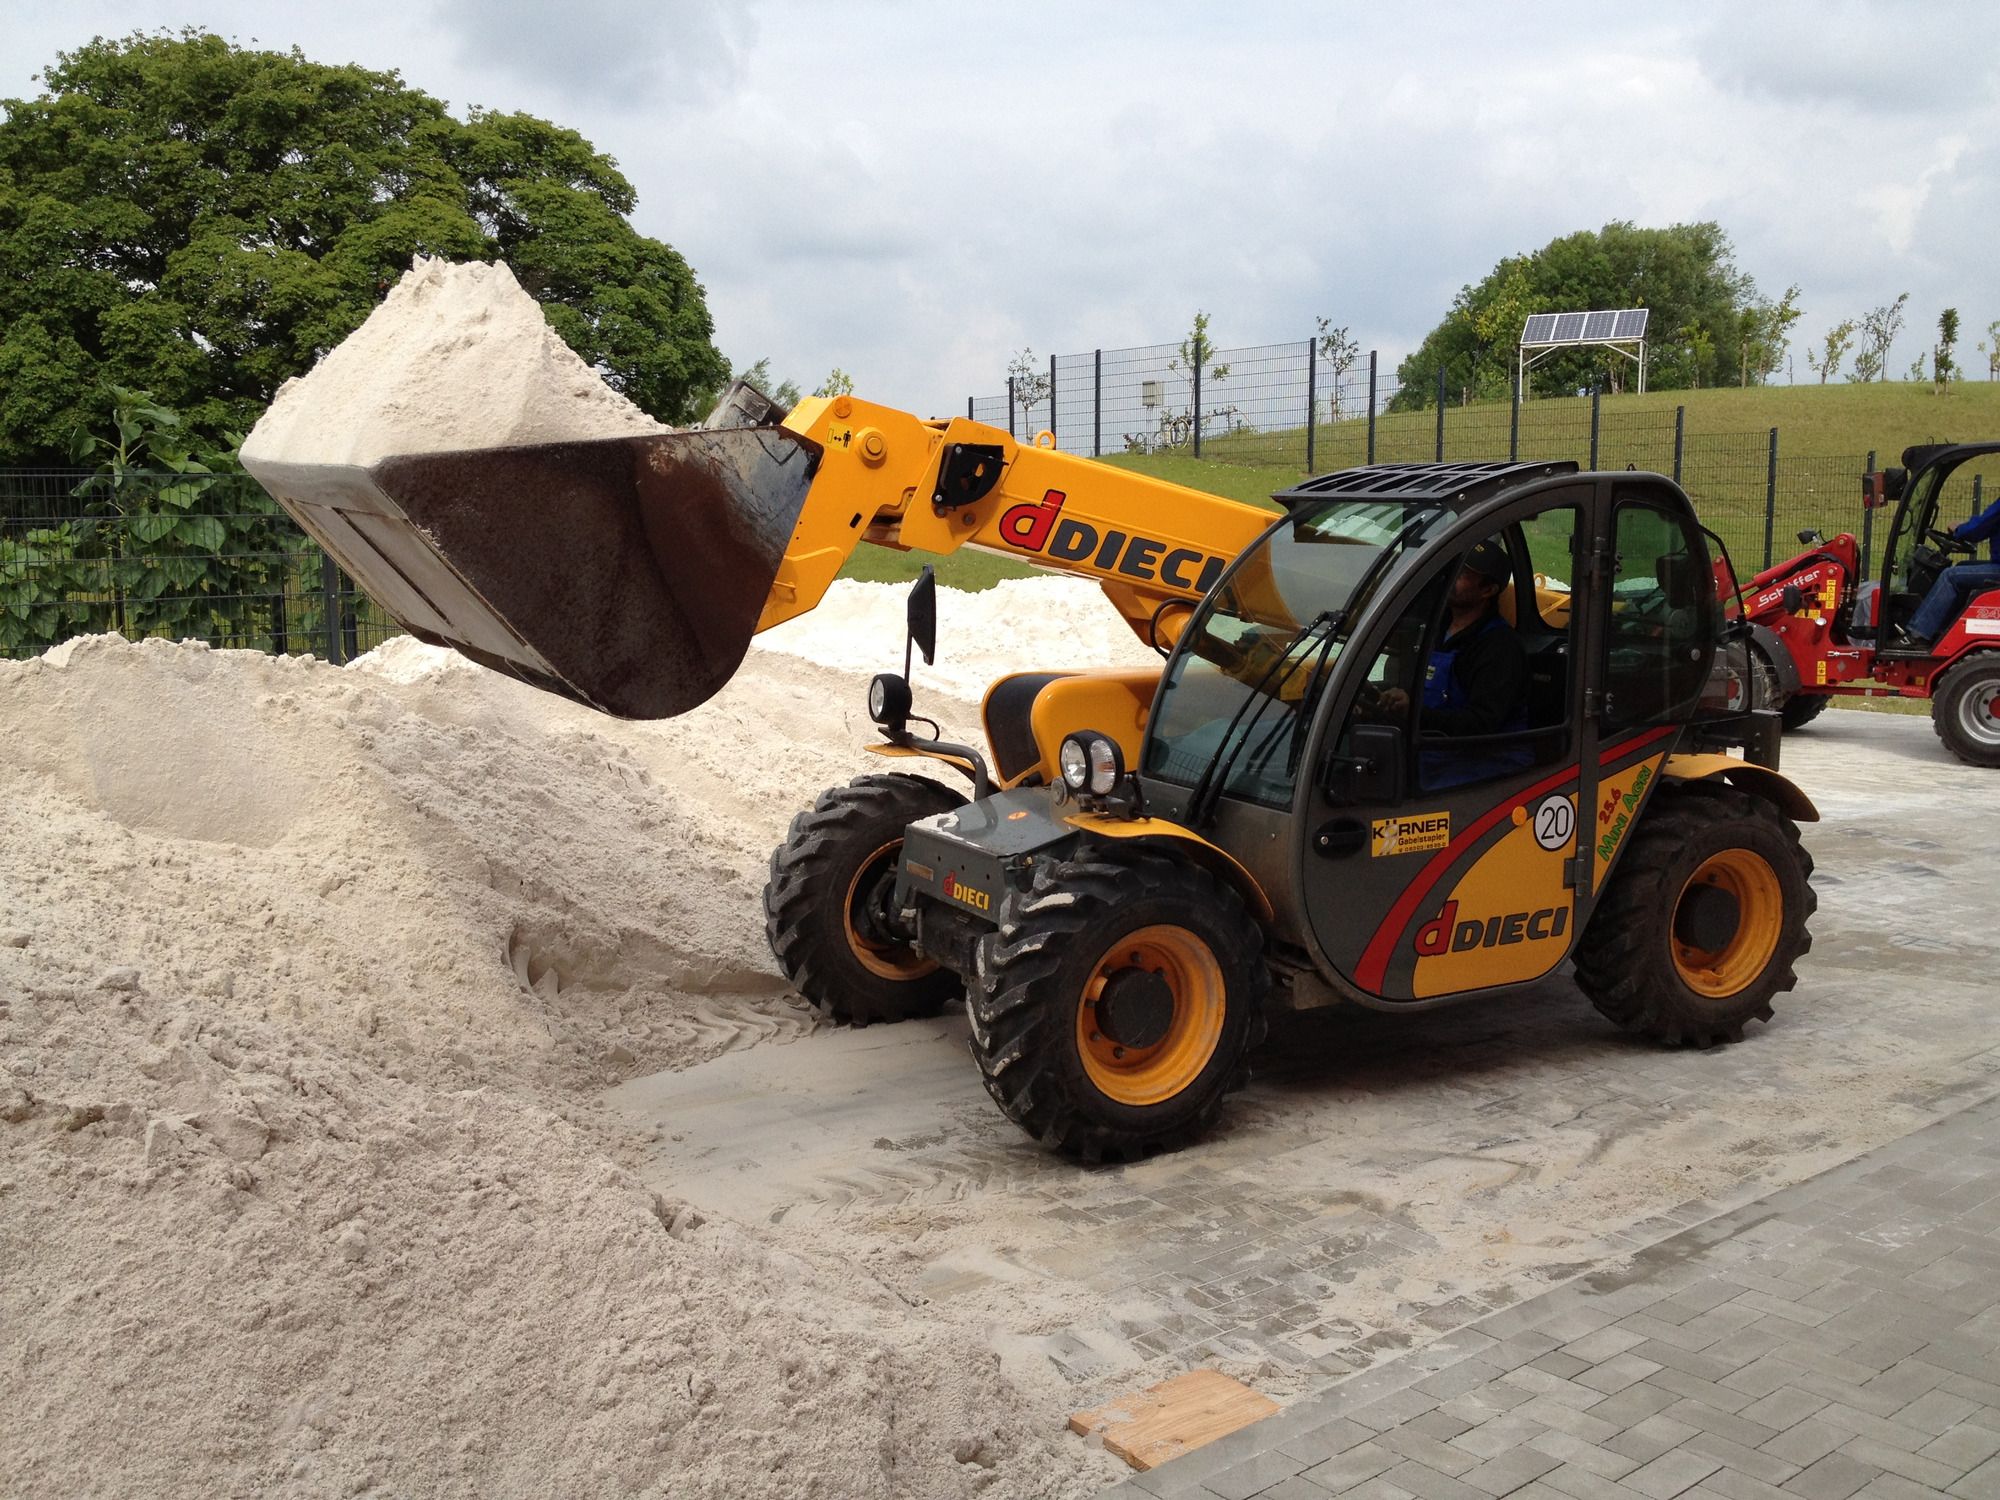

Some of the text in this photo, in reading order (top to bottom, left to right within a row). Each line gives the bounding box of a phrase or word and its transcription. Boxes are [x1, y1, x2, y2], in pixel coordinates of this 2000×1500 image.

[1541, 805, 1569, 840] 20
[1599, 787, 1622, 825] 25.6
[1399, 833, 1446, 846] Gabelstapler
